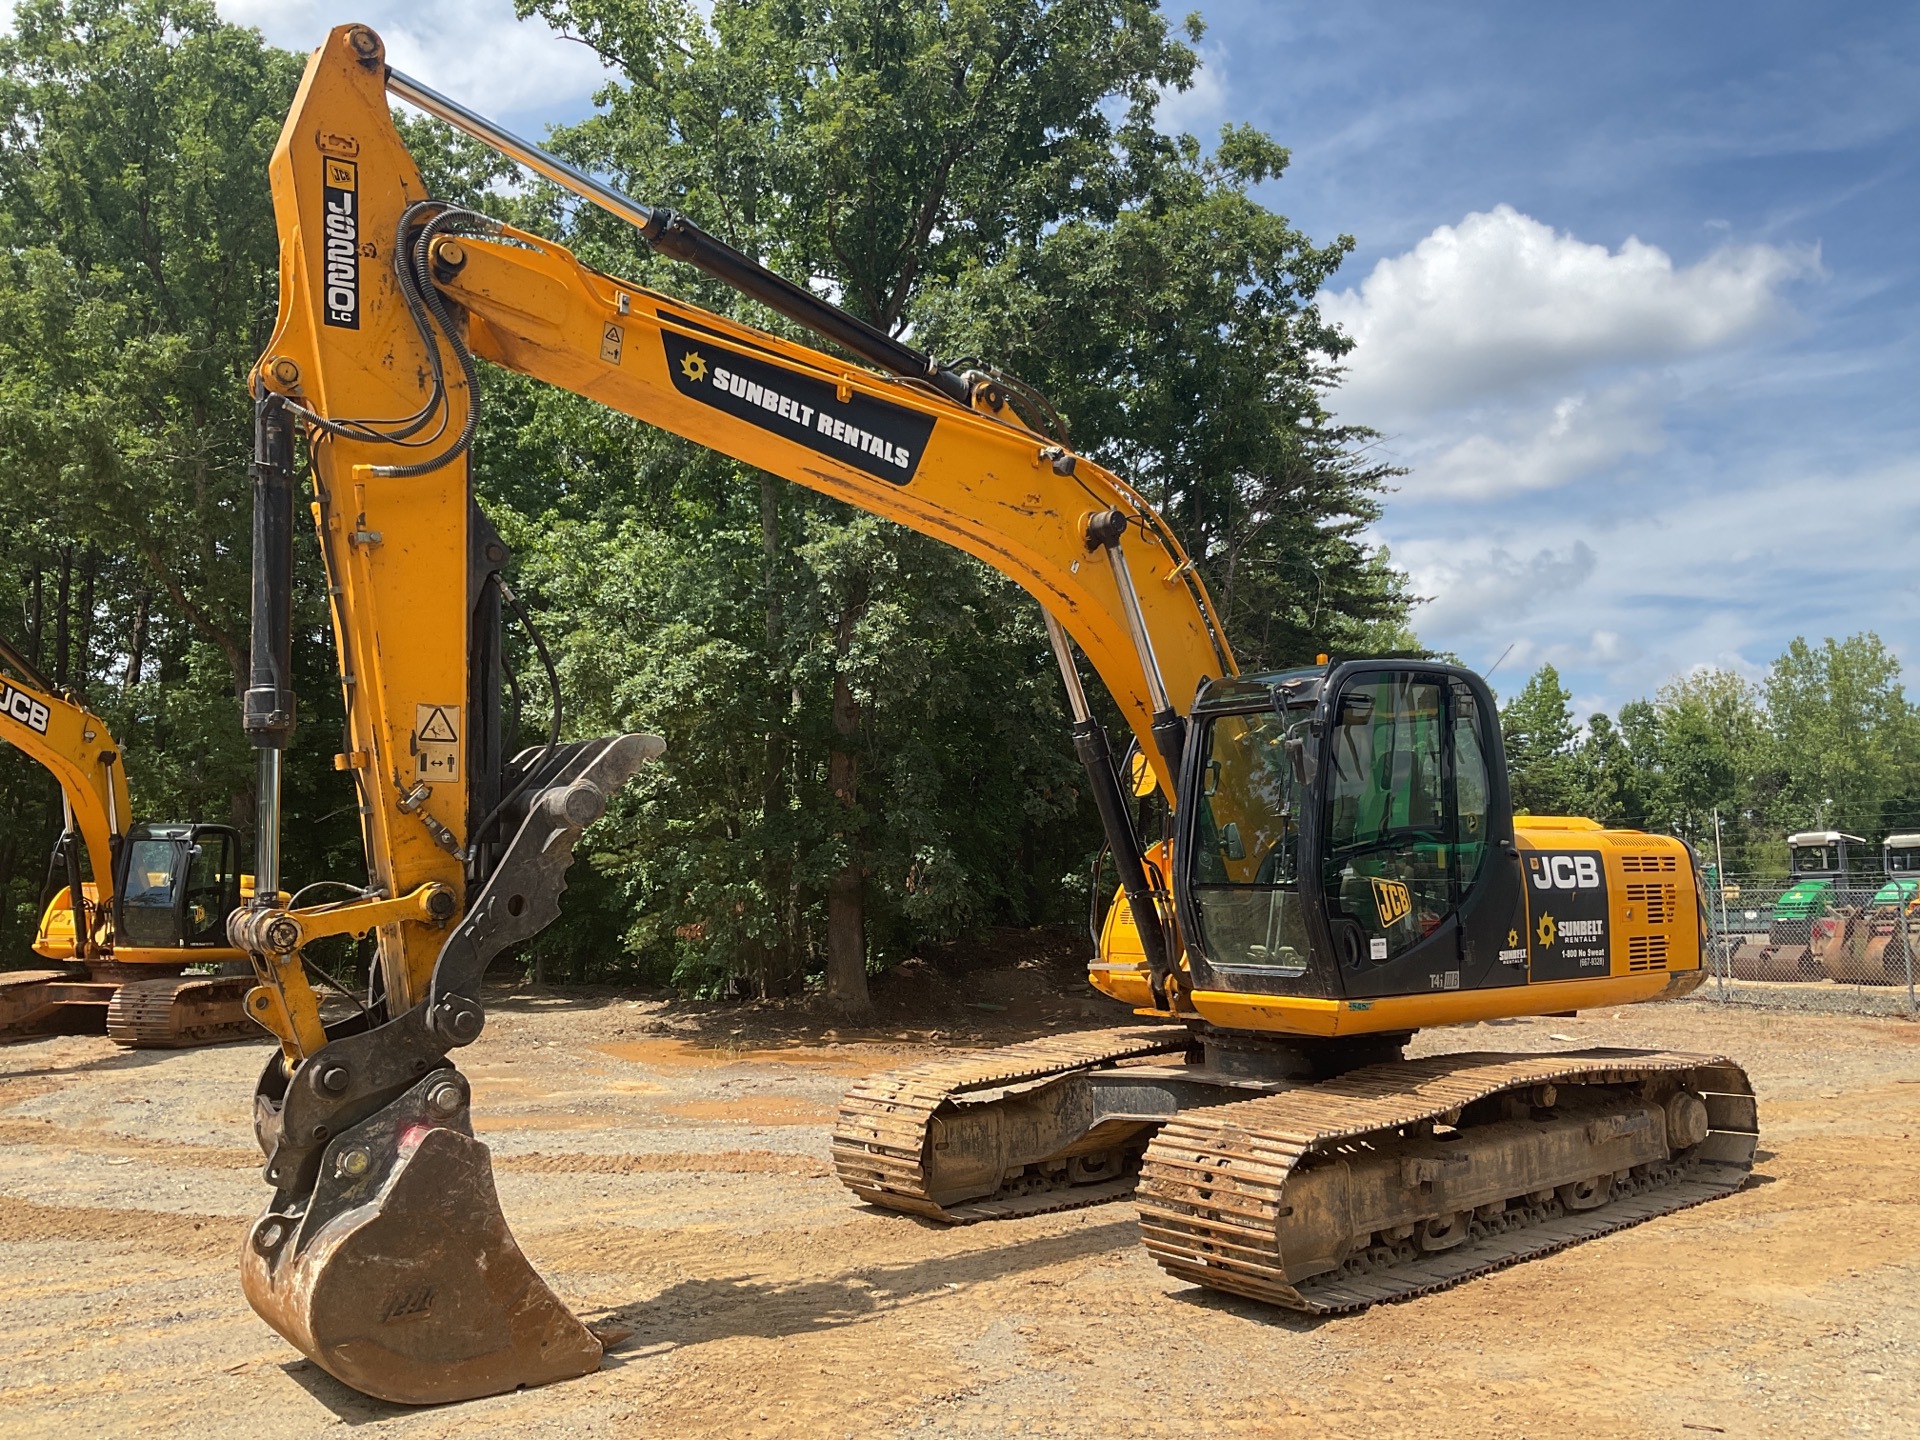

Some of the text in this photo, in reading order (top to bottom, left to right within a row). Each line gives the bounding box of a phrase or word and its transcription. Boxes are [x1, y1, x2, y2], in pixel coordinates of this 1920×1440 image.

[333, 167, 351, 182] JCB
[326, 192, 355, 322] JS220 LC
[712, 367, 910, 470] SUNBELT RENTALS
[0, 686, 49, 732] JCB
[1532, 855, 1600, 890] JCB
[1379, 882, 1410, 921] JCB
[1558, 919, 1603, 937] SUNBELT
[1564, 935, 1597, 944] RENTALS
[1498, 948, 1527, 961] SUNBELT
[1561, 948, 1604, 958] 1-800 No Sweat
[1429, 974, 1443, 989] T4i
